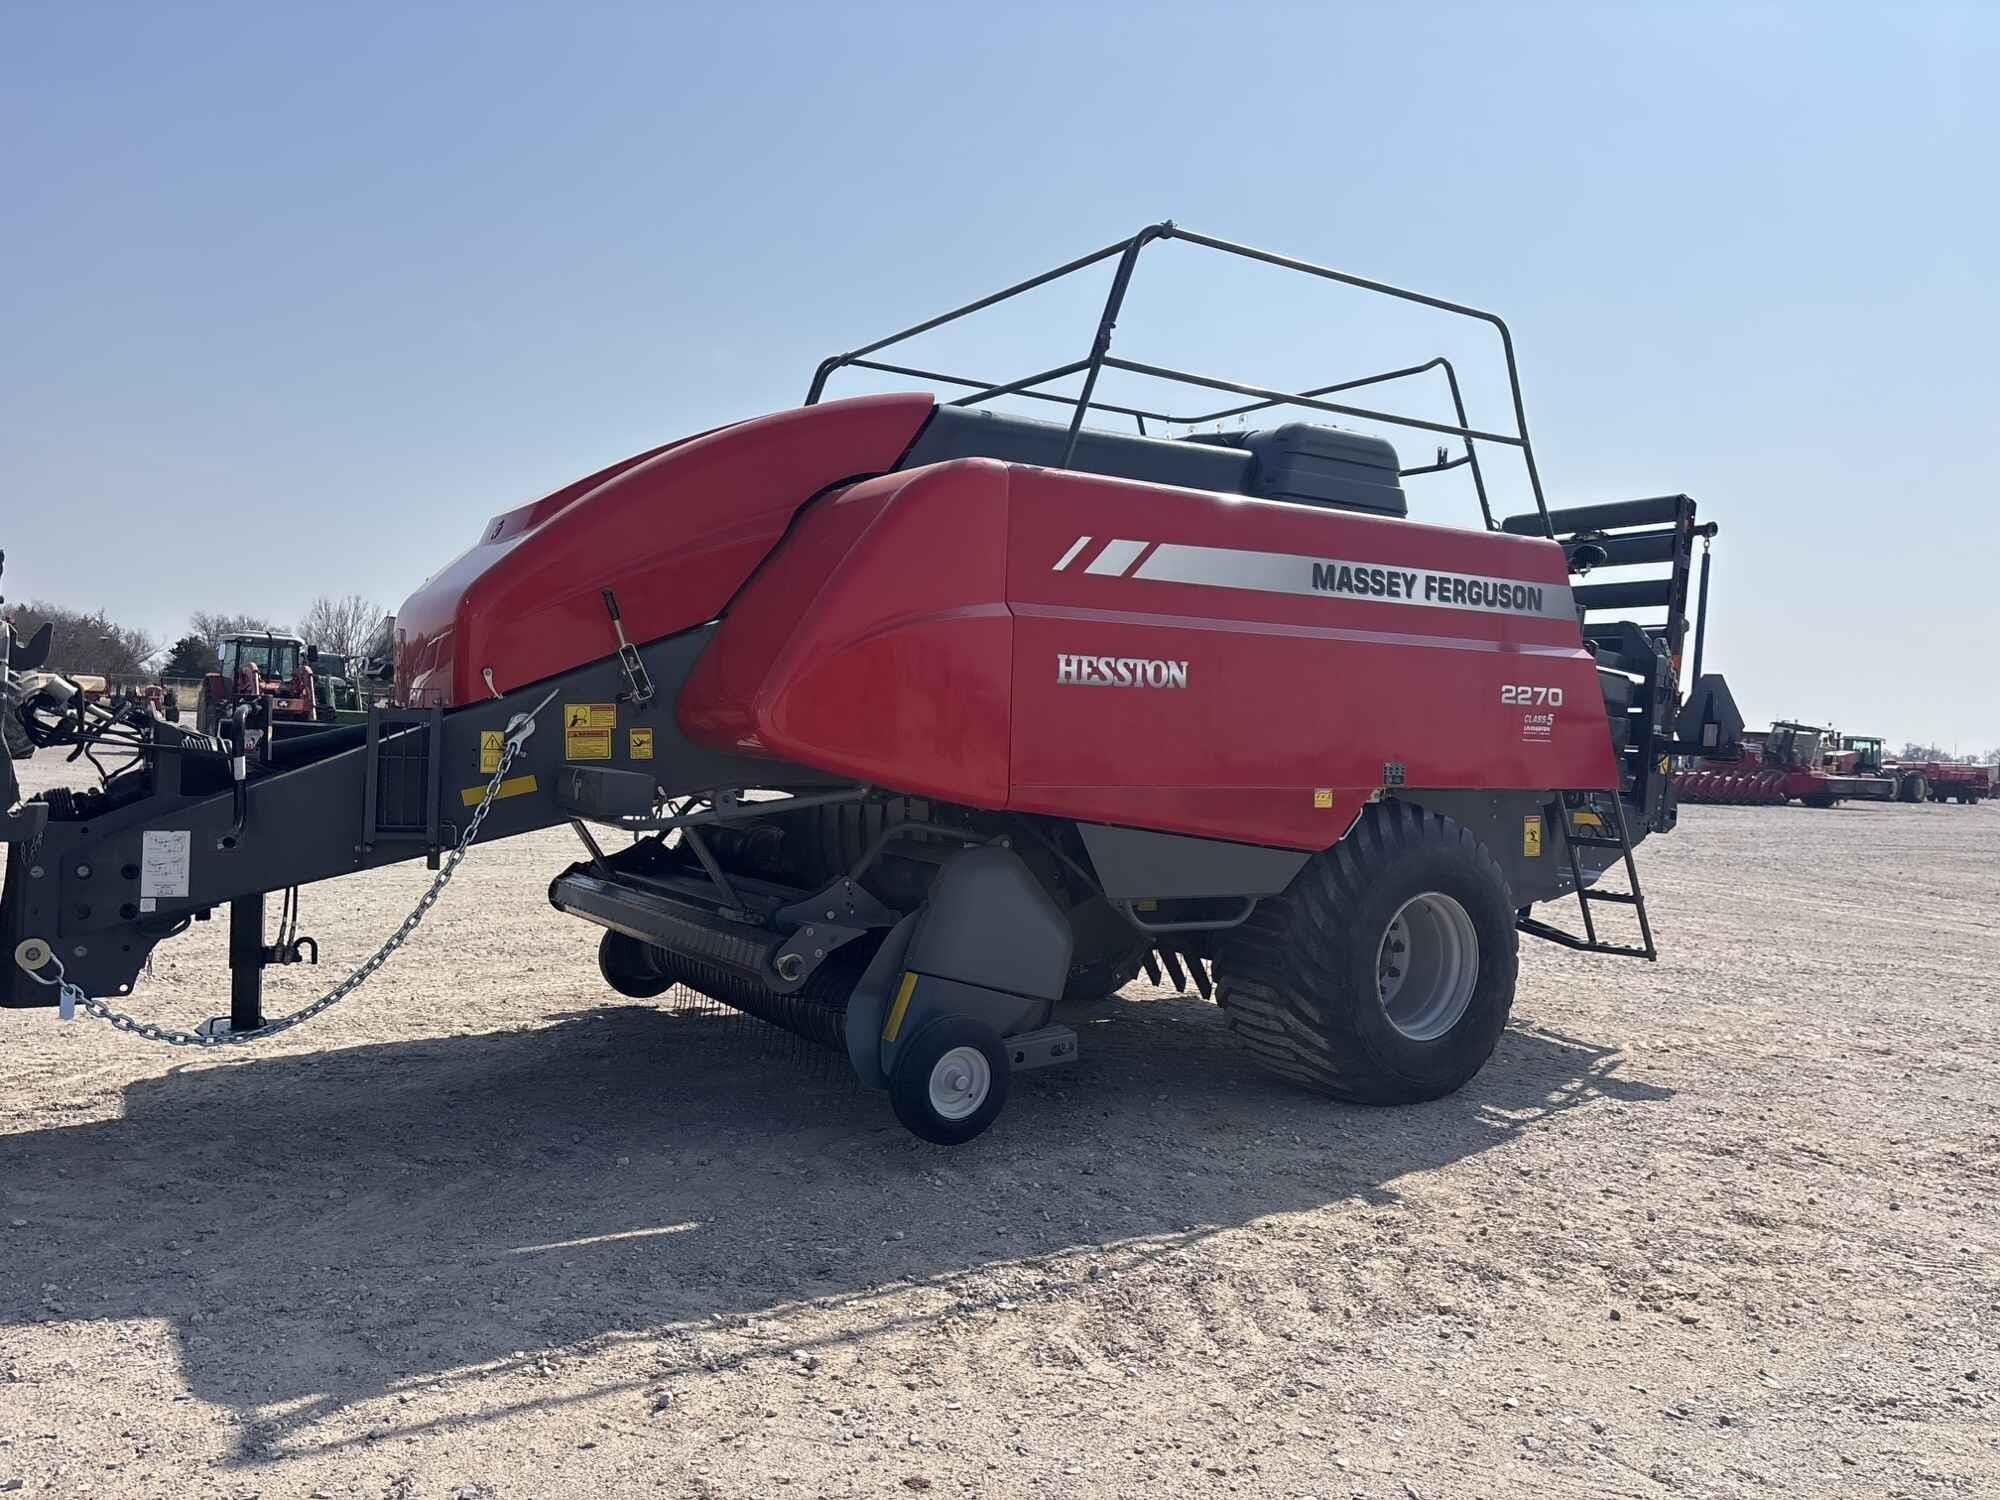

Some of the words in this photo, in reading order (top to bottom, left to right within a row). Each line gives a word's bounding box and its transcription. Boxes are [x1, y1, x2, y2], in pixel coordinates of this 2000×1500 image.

[1312, 562, 1417, 600] MASSEY
[1424, 575, 1543, 612] FERGUSON
[1056, 653, 1189, 689] HESSTON
[1501, 684, 1563, 707] 2270
